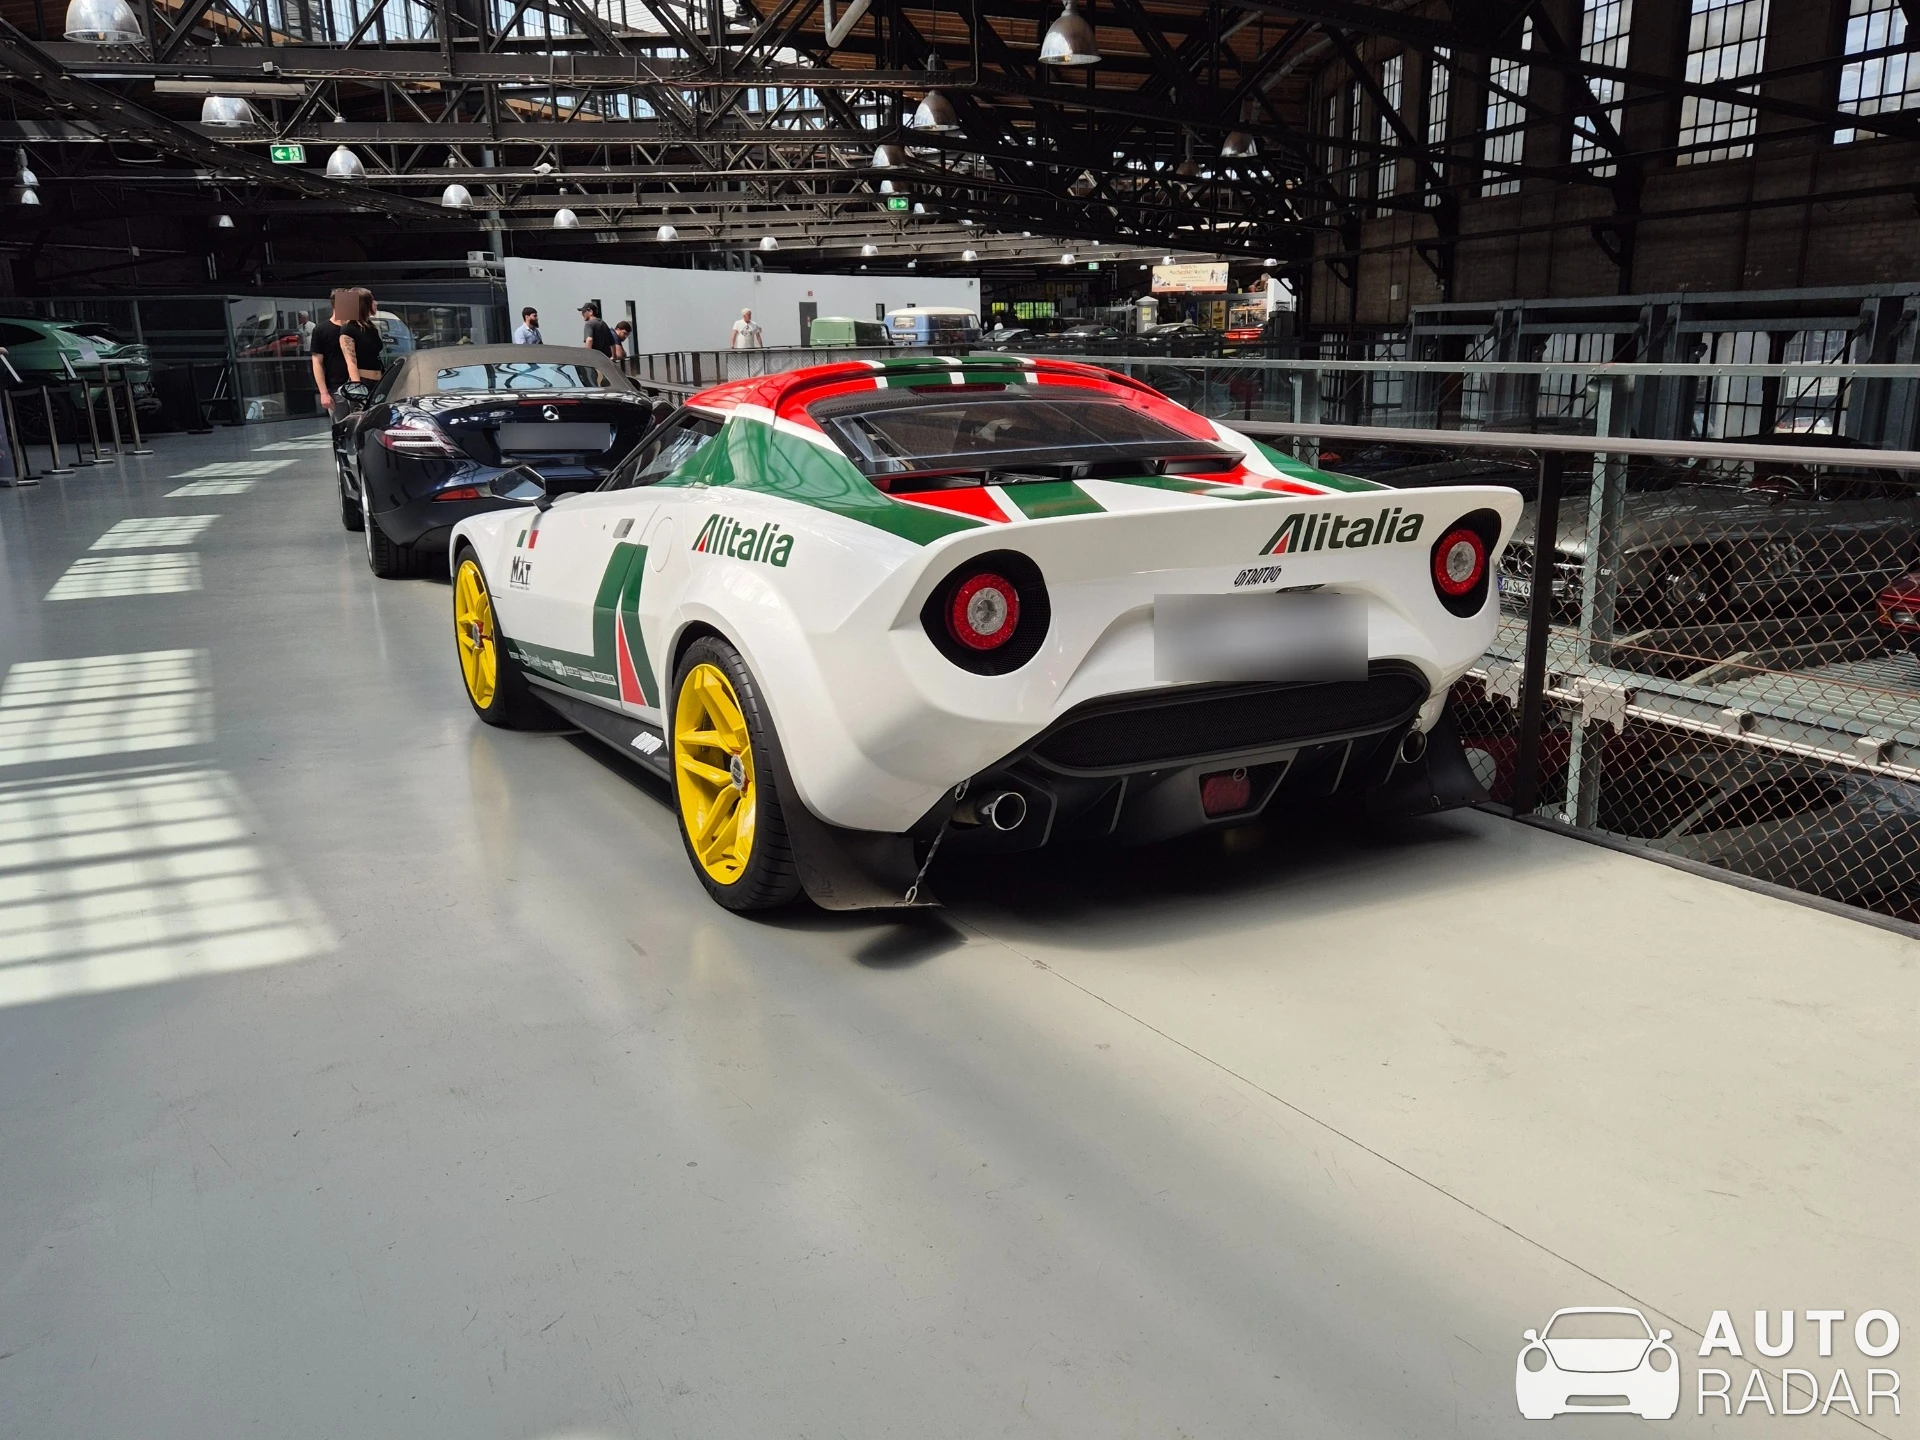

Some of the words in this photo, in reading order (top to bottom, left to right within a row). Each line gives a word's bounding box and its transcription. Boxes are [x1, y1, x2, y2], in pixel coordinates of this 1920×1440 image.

[692, 513, 795, 567] Alitalia
[1259, 508, 1424, 556] Alitalia
[1234, 565, 1282, 587] STRATOS
